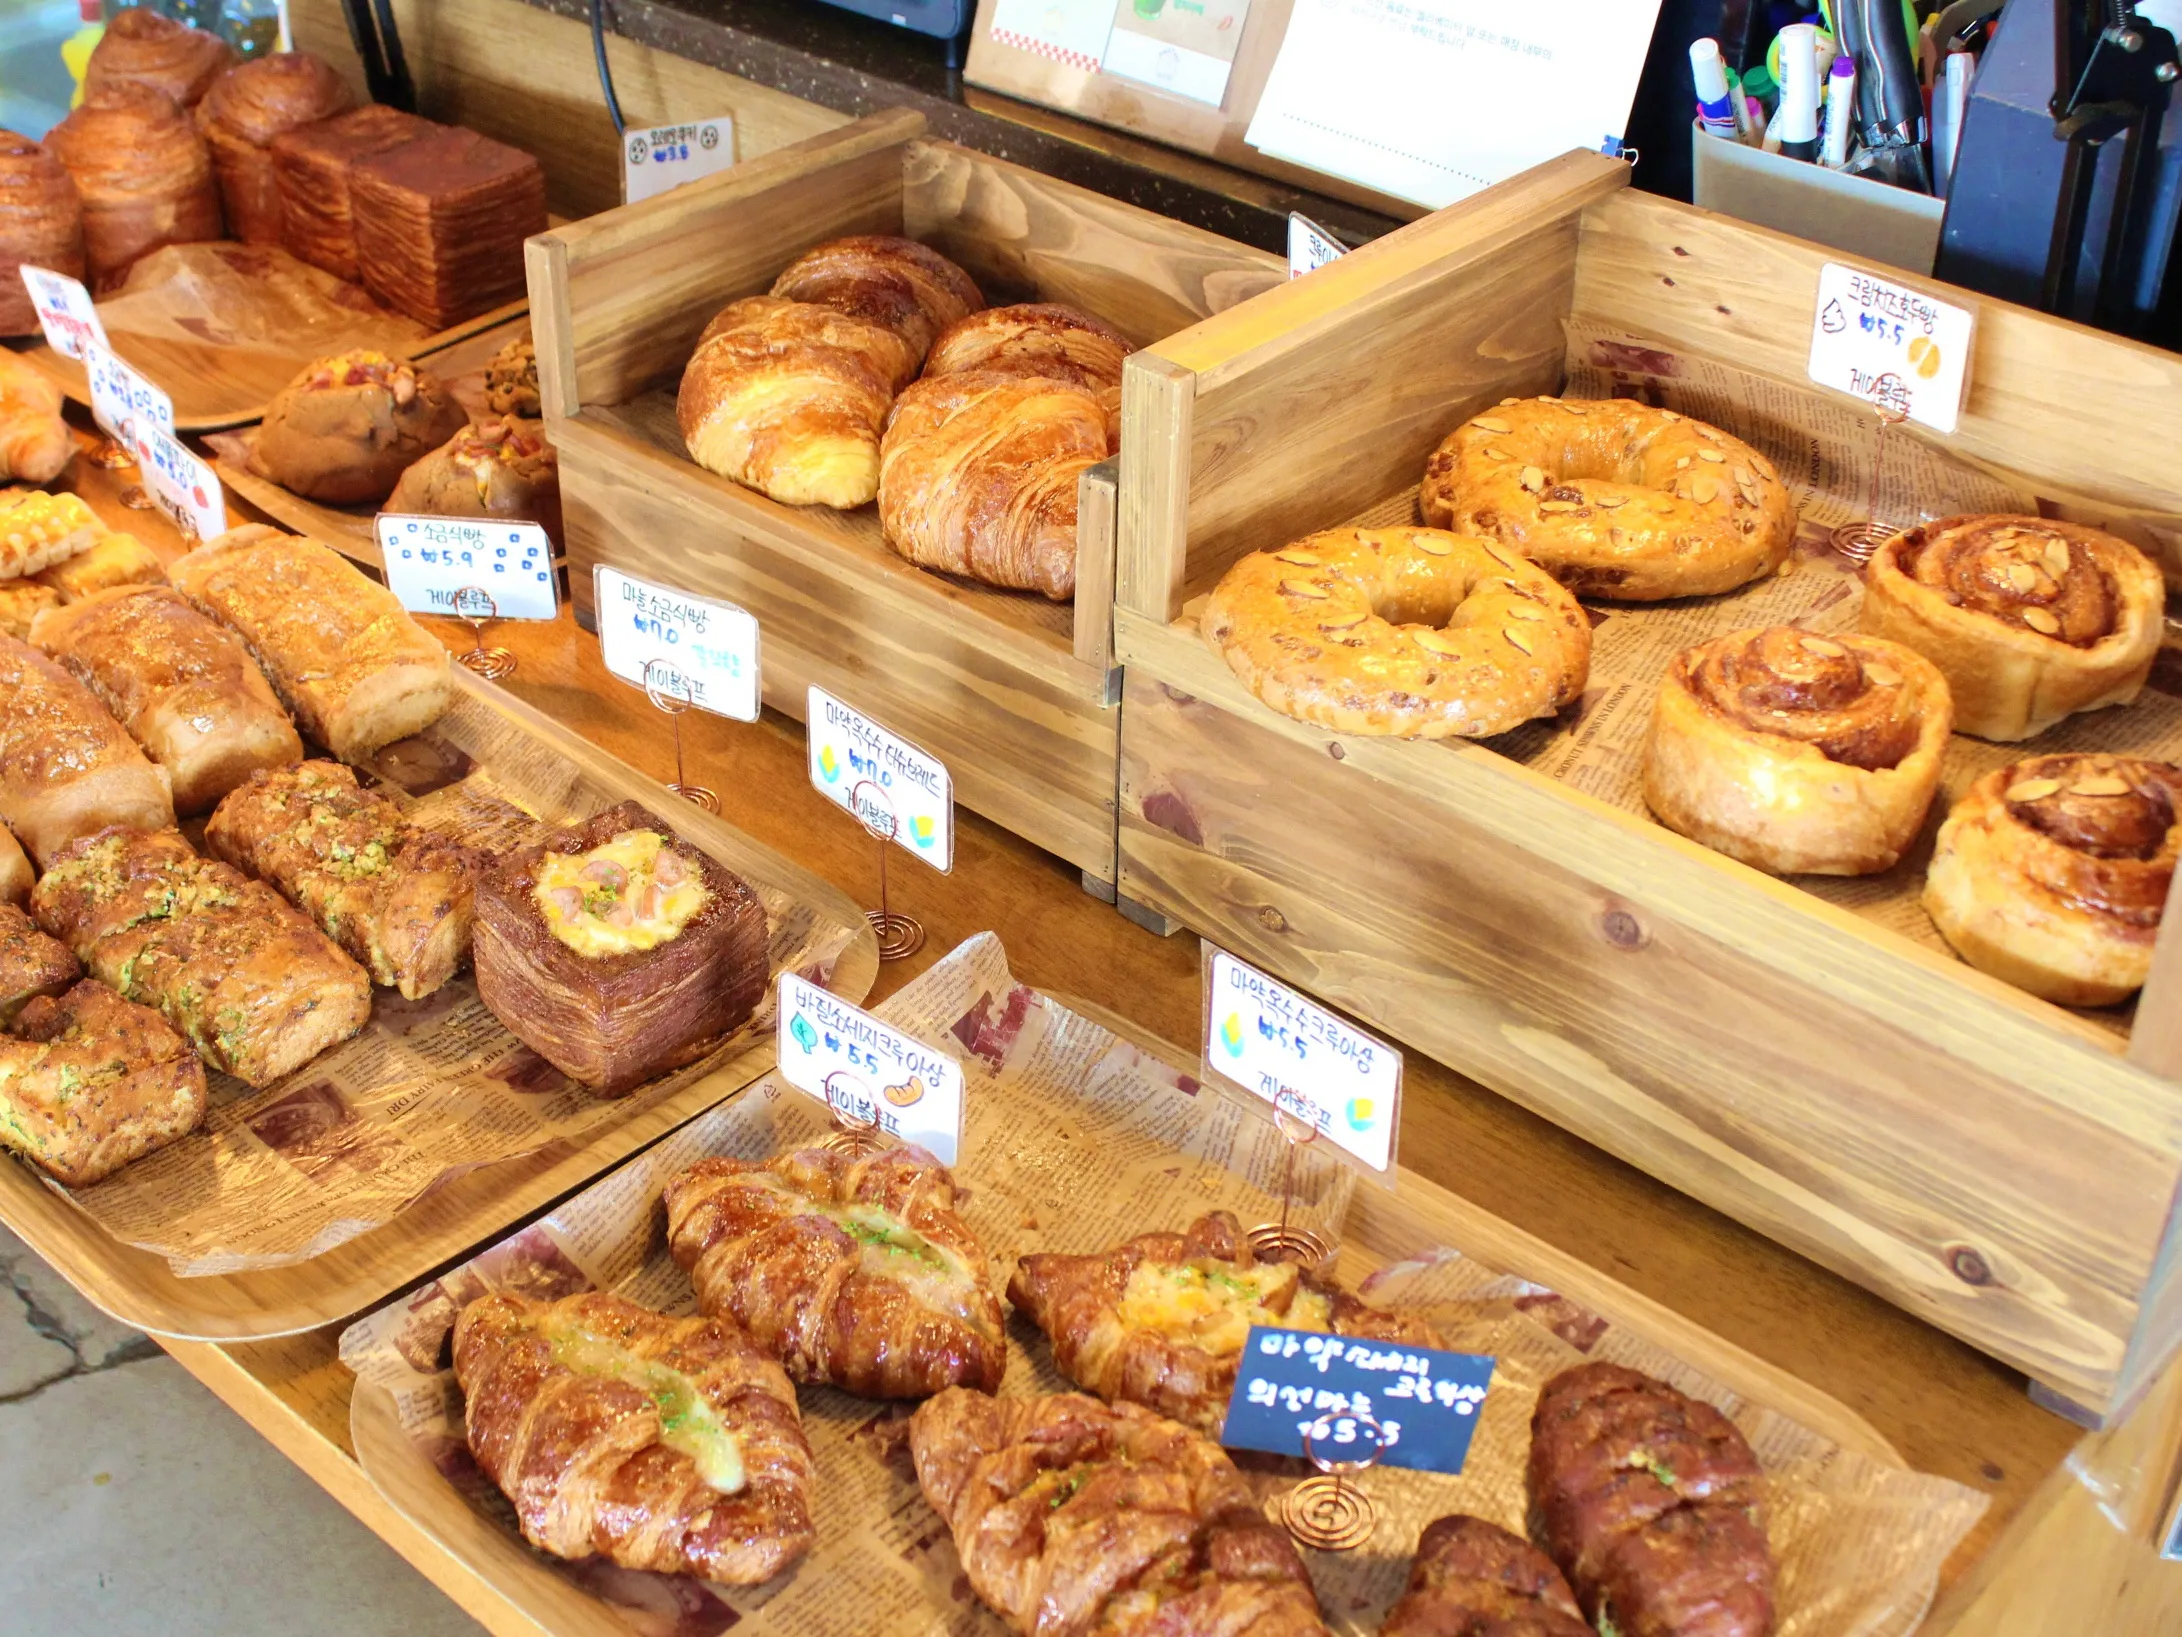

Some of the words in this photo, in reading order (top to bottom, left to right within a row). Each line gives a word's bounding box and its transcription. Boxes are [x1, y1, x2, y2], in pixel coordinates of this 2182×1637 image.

[1478, 30, 1498, 44] 또는
[1500, 36, 1520, 51] 매장
[1523, 43, 1553, 60] 내부의
[424, 523, 487, 550] 소금식빵
